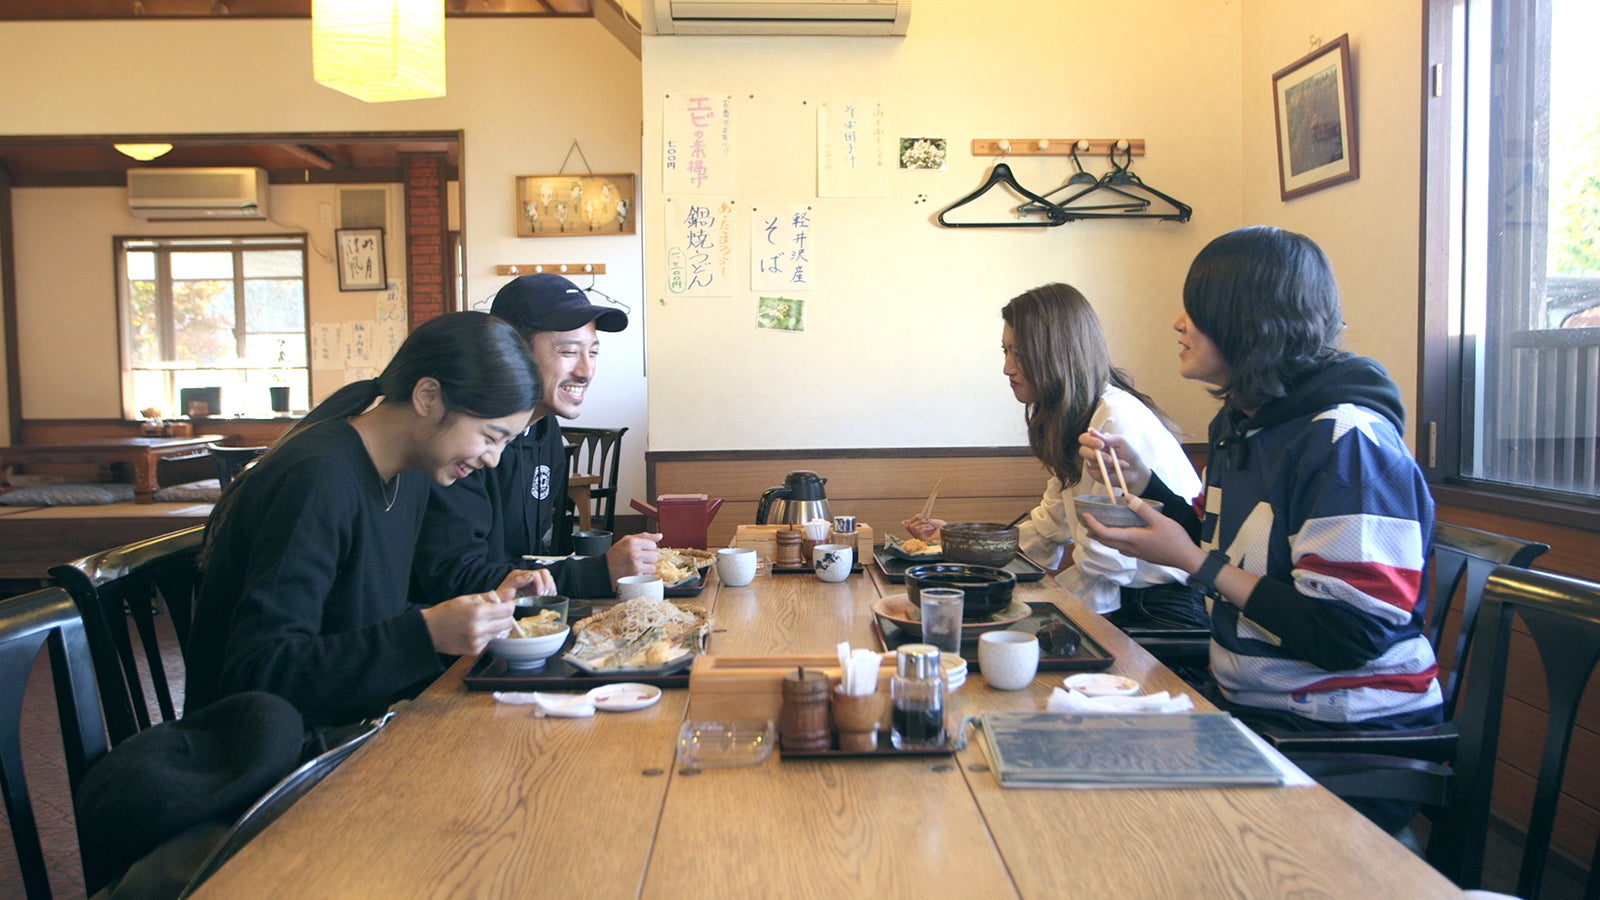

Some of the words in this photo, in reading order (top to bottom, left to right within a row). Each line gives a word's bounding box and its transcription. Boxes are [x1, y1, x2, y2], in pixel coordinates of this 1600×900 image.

[684, 204, 715, 290] 鍋焼うどん
[760, 216, 785, 273] そば
[790, 212, 811, 283] 軽井沢産
